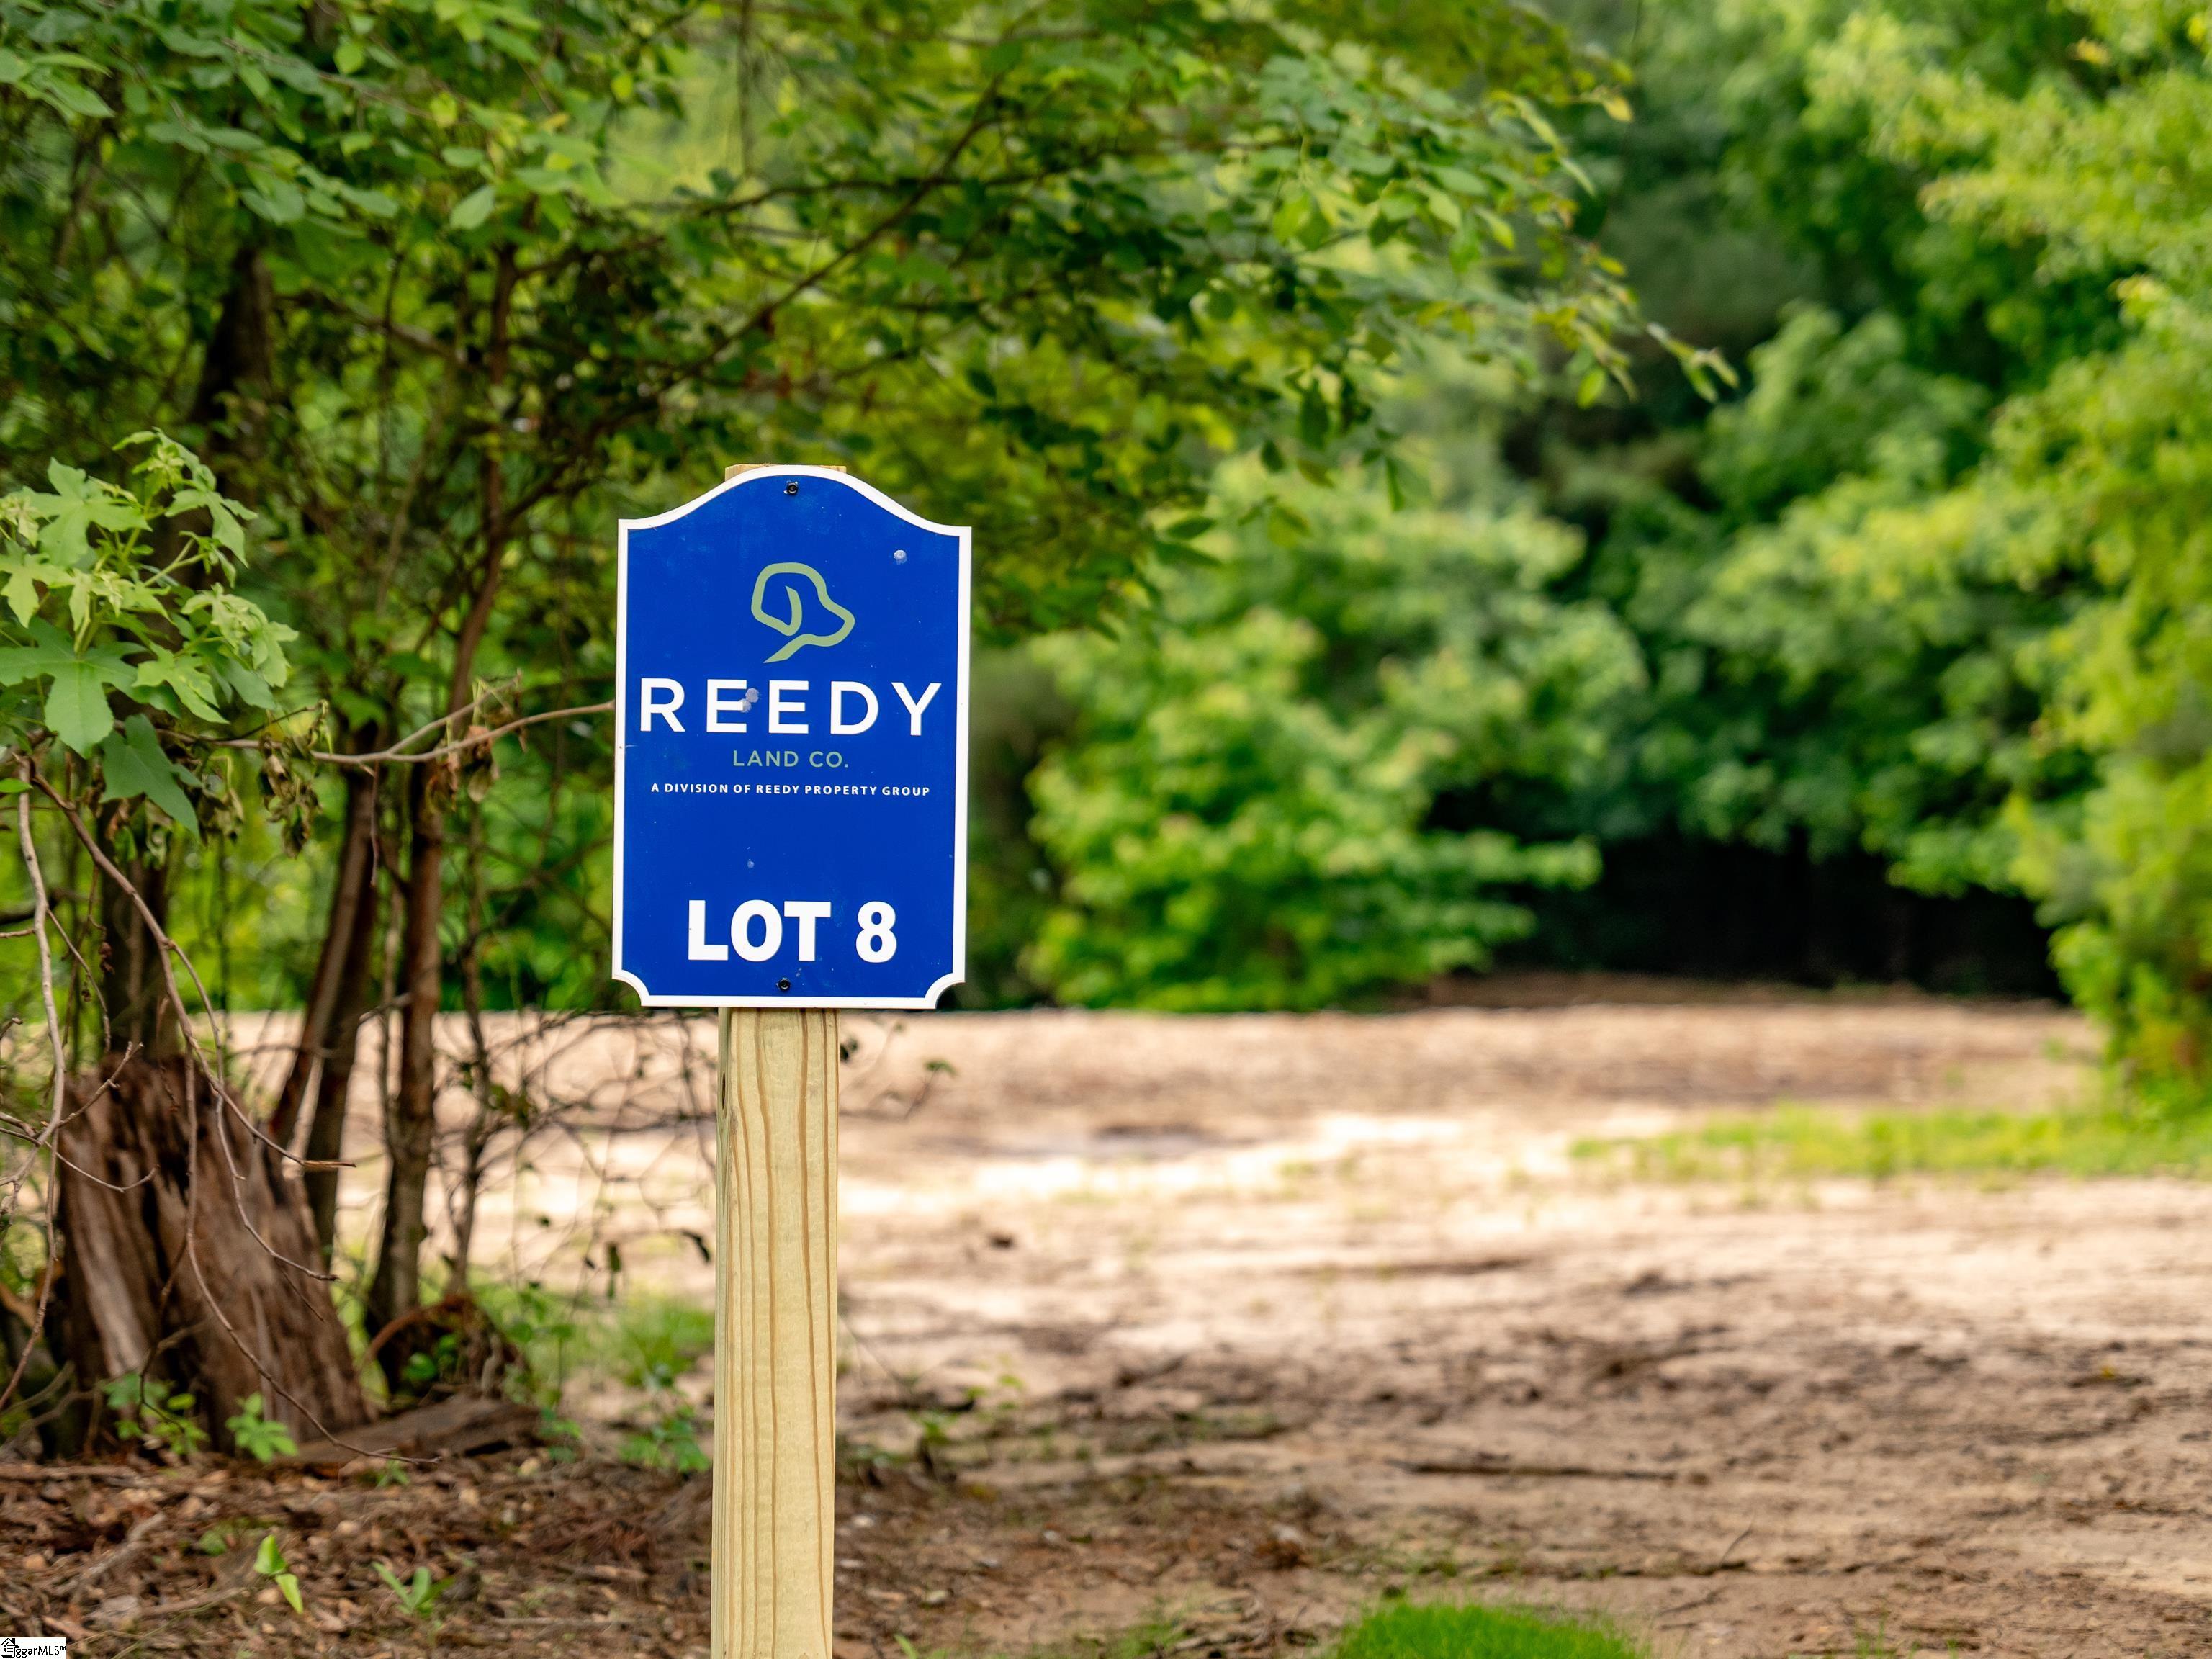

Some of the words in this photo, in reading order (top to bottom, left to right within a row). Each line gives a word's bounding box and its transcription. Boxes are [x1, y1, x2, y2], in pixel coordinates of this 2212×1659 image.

[640, 678, 942, 737] REEDY
[733, 750, 799, 767] LAND
[809, 751, 849, 768] CO.
[651, 783, 660, 793] A
[665, 783, 728, 793] DIVISION
[733, 784, 751, 793] OF
[756, 784, 800, 794] REEDY
[804, 785, 877, 796] PROPERTY
[881, 786, 930, 796] GROUP
[688, 899, 832, 962] LOT
[855, 901, 897, 963] 8
